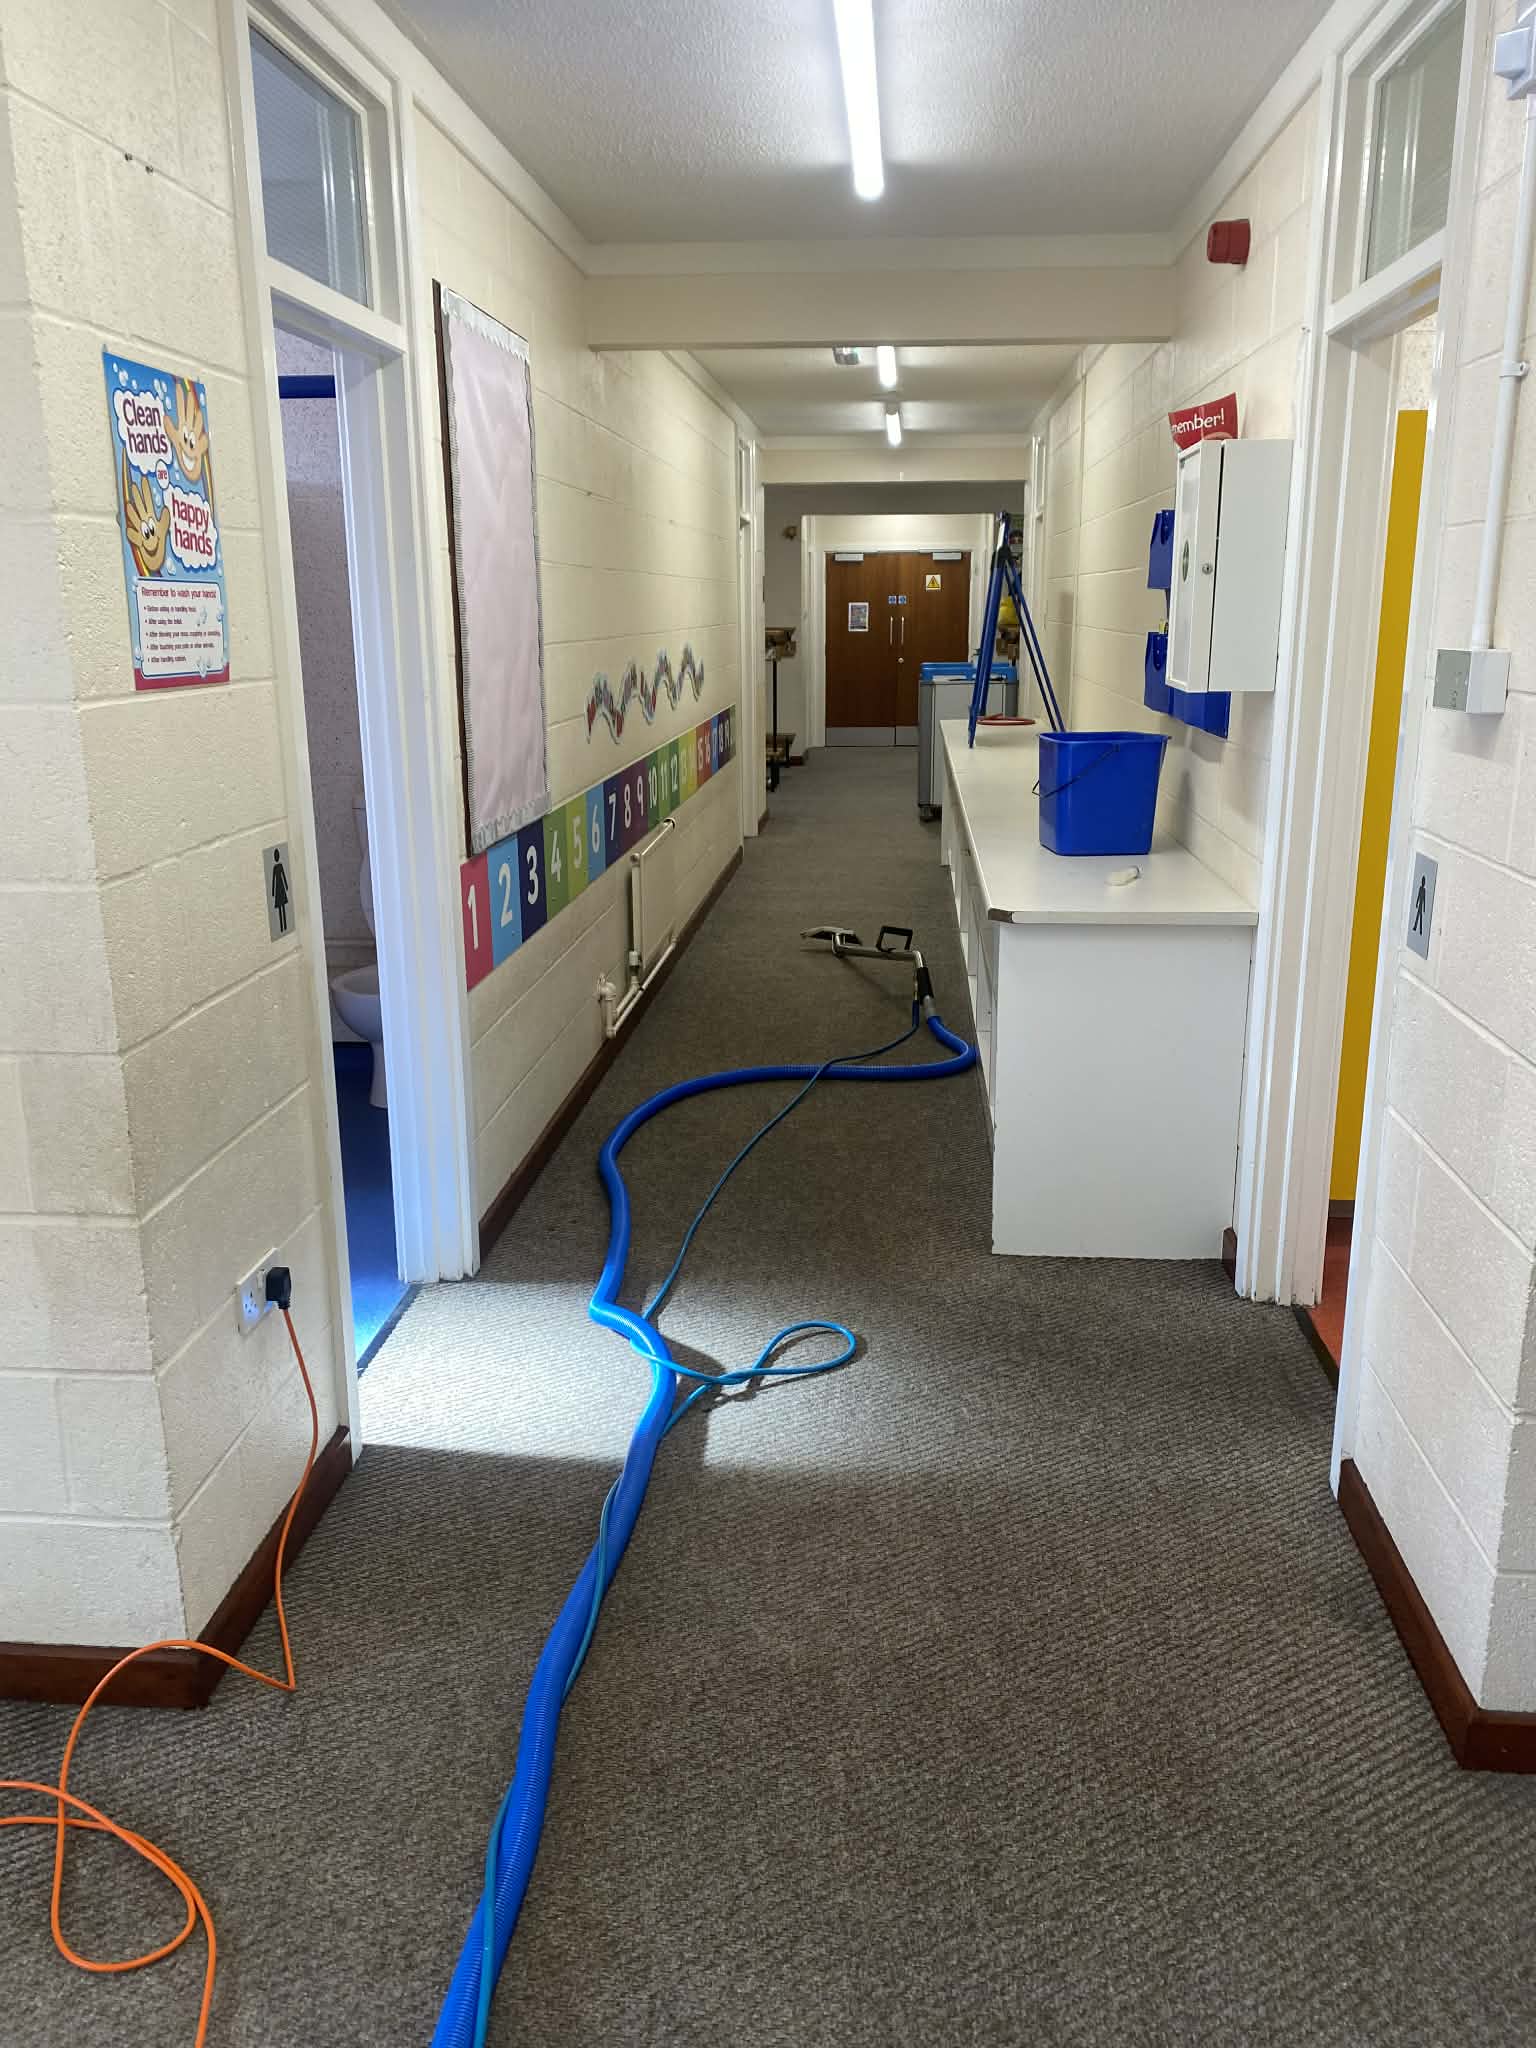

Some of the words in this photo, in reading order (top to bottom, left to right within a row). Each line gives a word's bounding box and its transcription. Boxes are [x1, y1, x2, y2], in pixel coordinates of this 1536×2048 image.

[123, 399, 161, 427] Clean
[127, 427, 169, 454] hands
[157, 469, 168, 481] are
[171, 493, 210, 532] happy
[174, 522, 213, 556] hands
[467, 884, 479, 951] 1
[498, 863, 513, 928] 2
[526, 845, 539, 905] 3
[550, 831, 562, 883] 4
[572, 815, 582, 869] 5
[591, 804, 600, 854] 6
[608, 792, 617, 841] 7
[623, 783, 632, 829] 8
[637, 775, 645, 817] 9
[648, 765, 658, 809] 10
[660, 760, 668, 802] 11
[670, 753, 679, 793] 12
